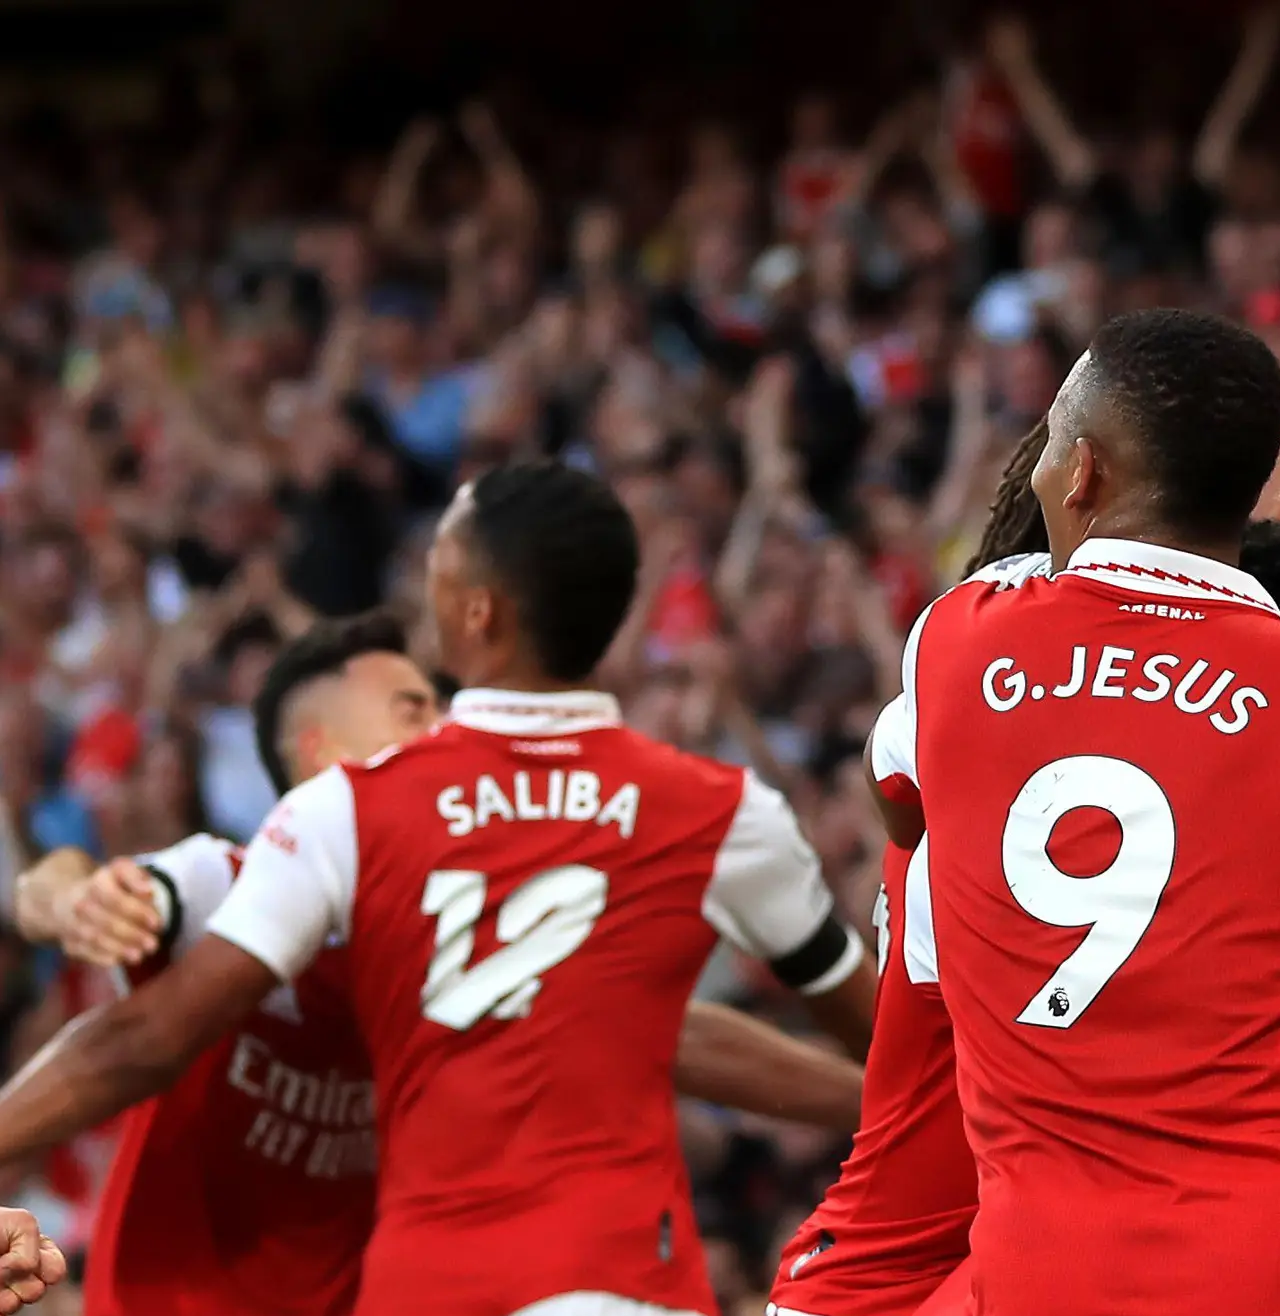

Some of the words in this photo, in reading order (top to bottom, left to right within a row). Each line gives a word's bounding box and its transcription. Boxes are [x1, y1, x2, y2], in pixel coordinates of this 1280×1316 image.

[982, 644, 1269, 734] G.JESUS
[436, 768, 641, 840] SALIBA
[420, 862, 609, 1032] 12
[1001, 754, 1177, 1030] 9
